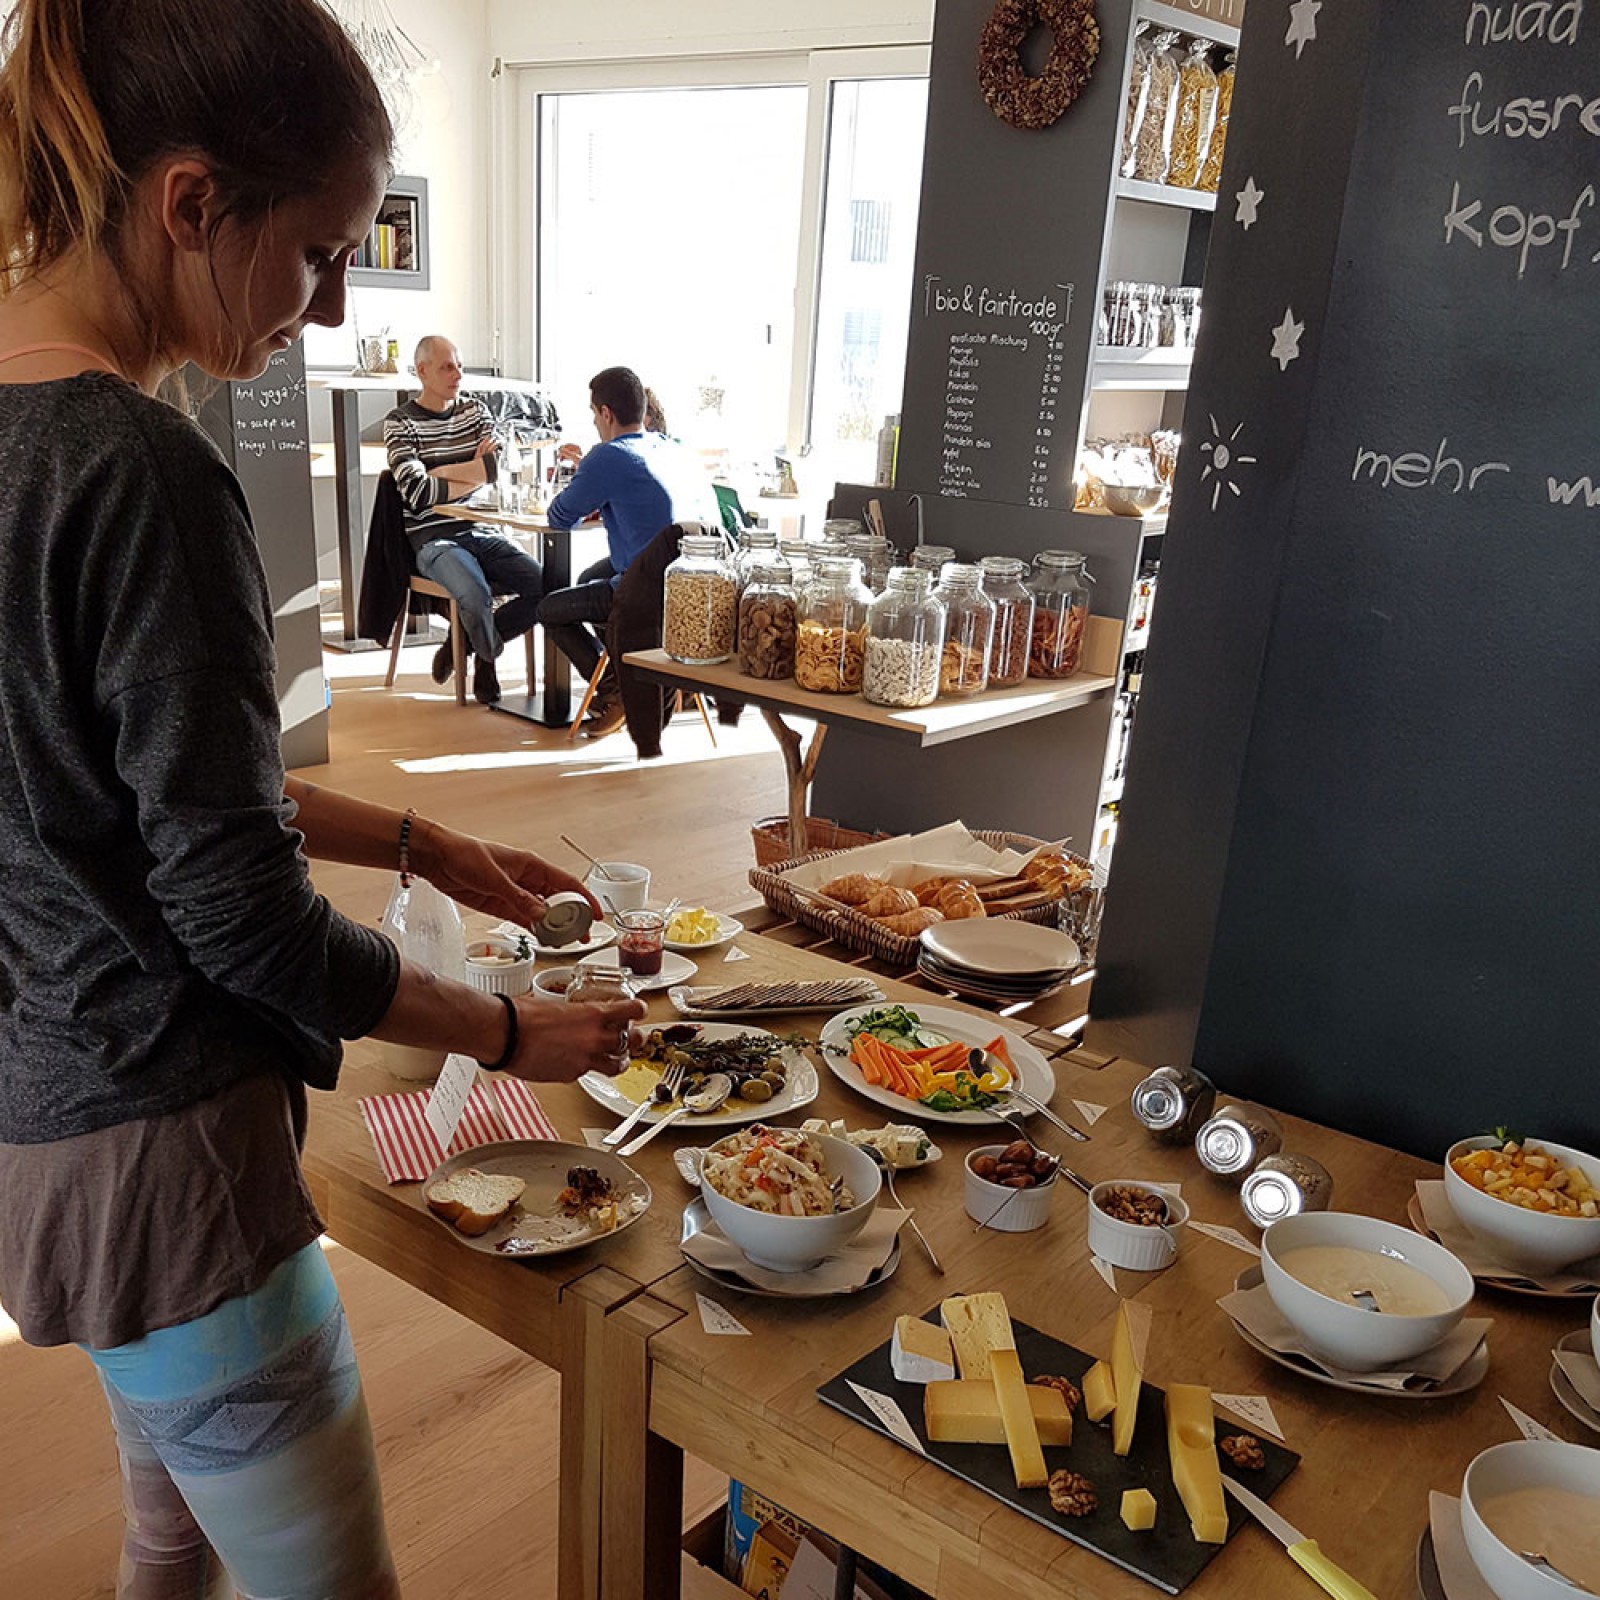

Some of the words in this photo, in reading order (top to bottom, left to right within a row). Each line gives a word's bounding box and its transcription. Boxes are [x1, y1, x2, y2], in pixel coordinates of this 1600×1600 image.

[935, 289, 960, 311] bio
[978, 286, 1058, 318] fairtrade
[1351, 436, 1511, 494] mehr
